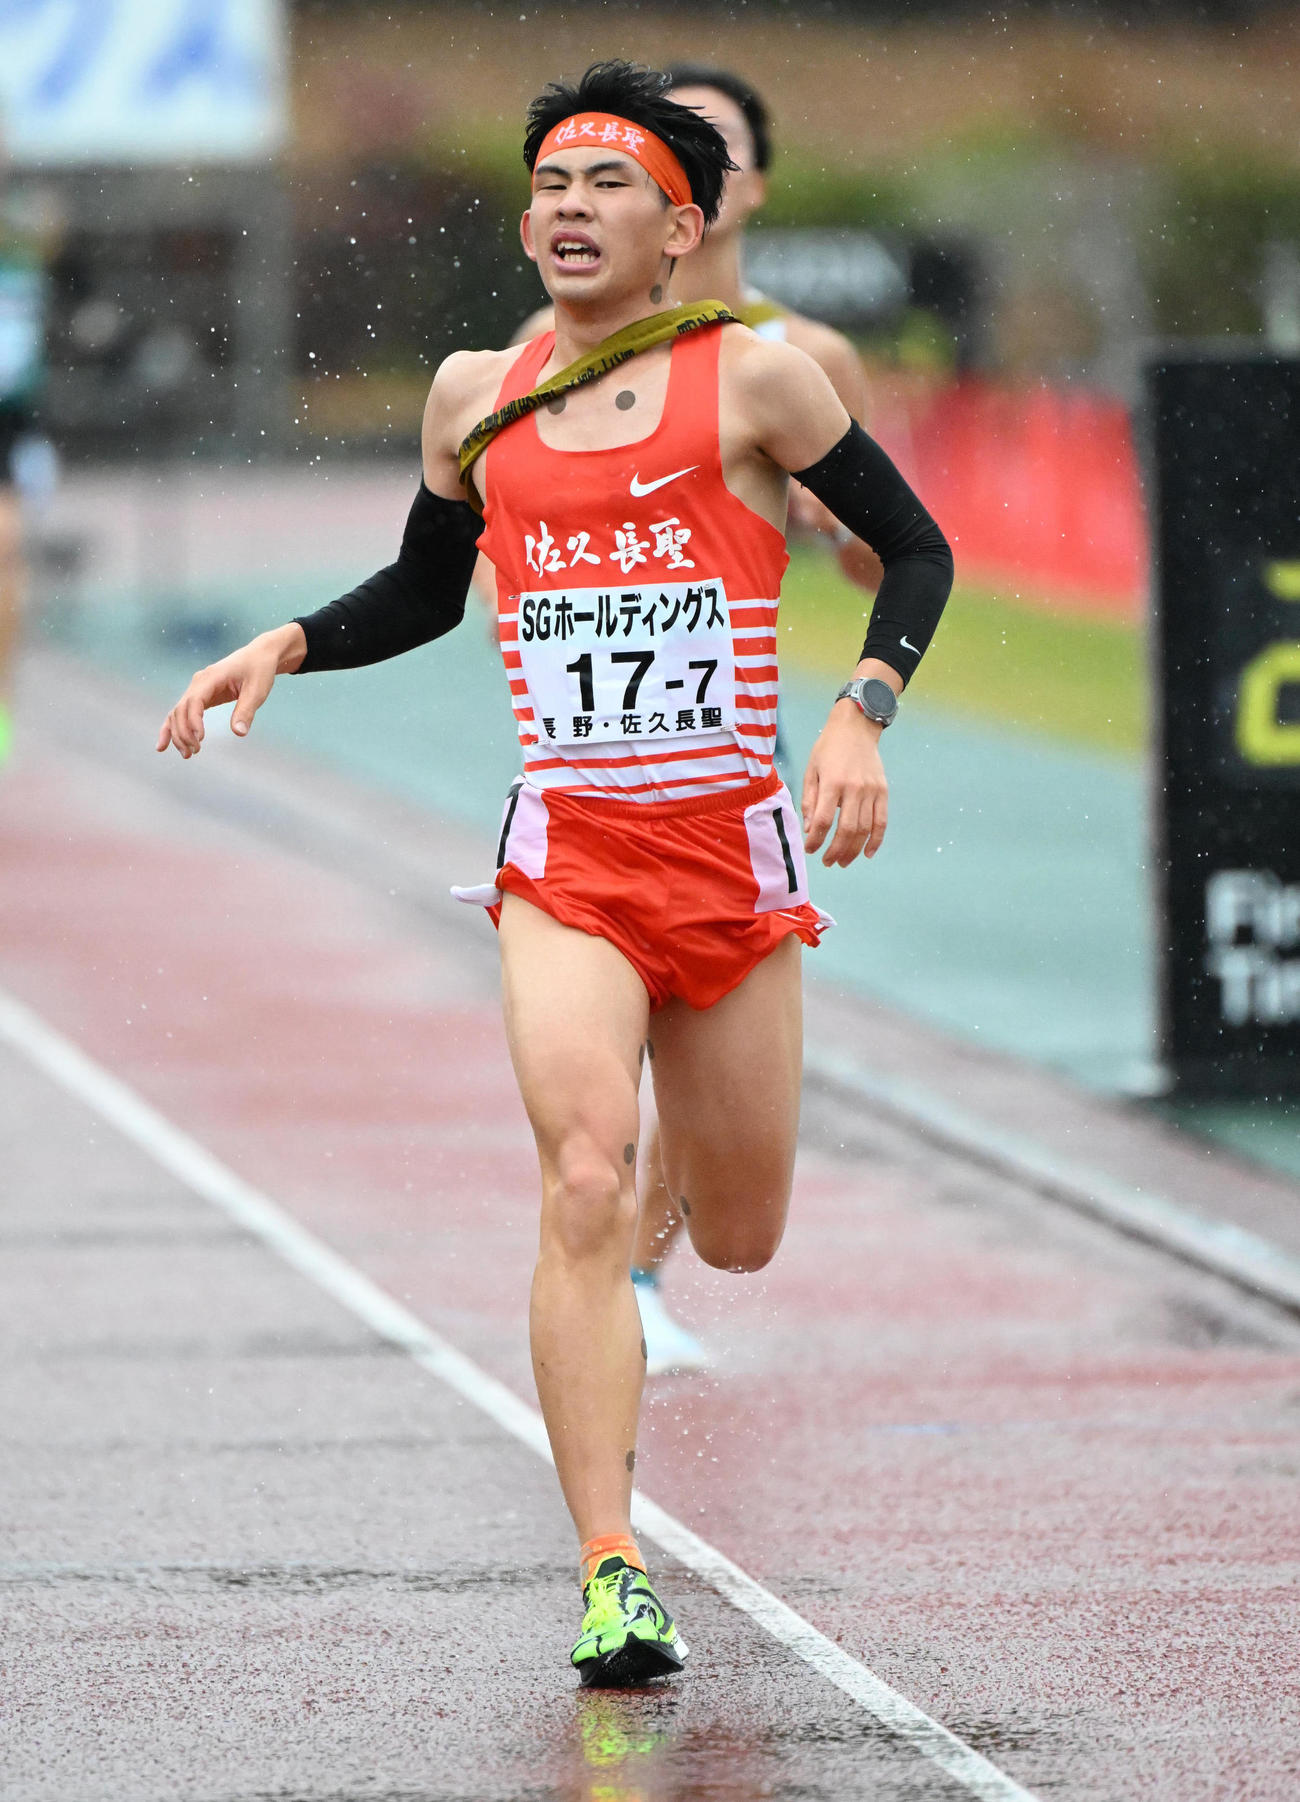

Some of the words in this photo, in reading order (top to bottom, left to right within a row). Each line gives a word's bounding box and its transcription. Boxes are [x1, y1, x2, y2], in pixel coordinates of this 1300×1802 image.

[554, 118, 646, 155] 佐久長聖
[524, 517, 696, 578] 佐久長聖
[522, 586, 725, 642] SGホールディングス
[566, 650, 718, 712] 17-7
